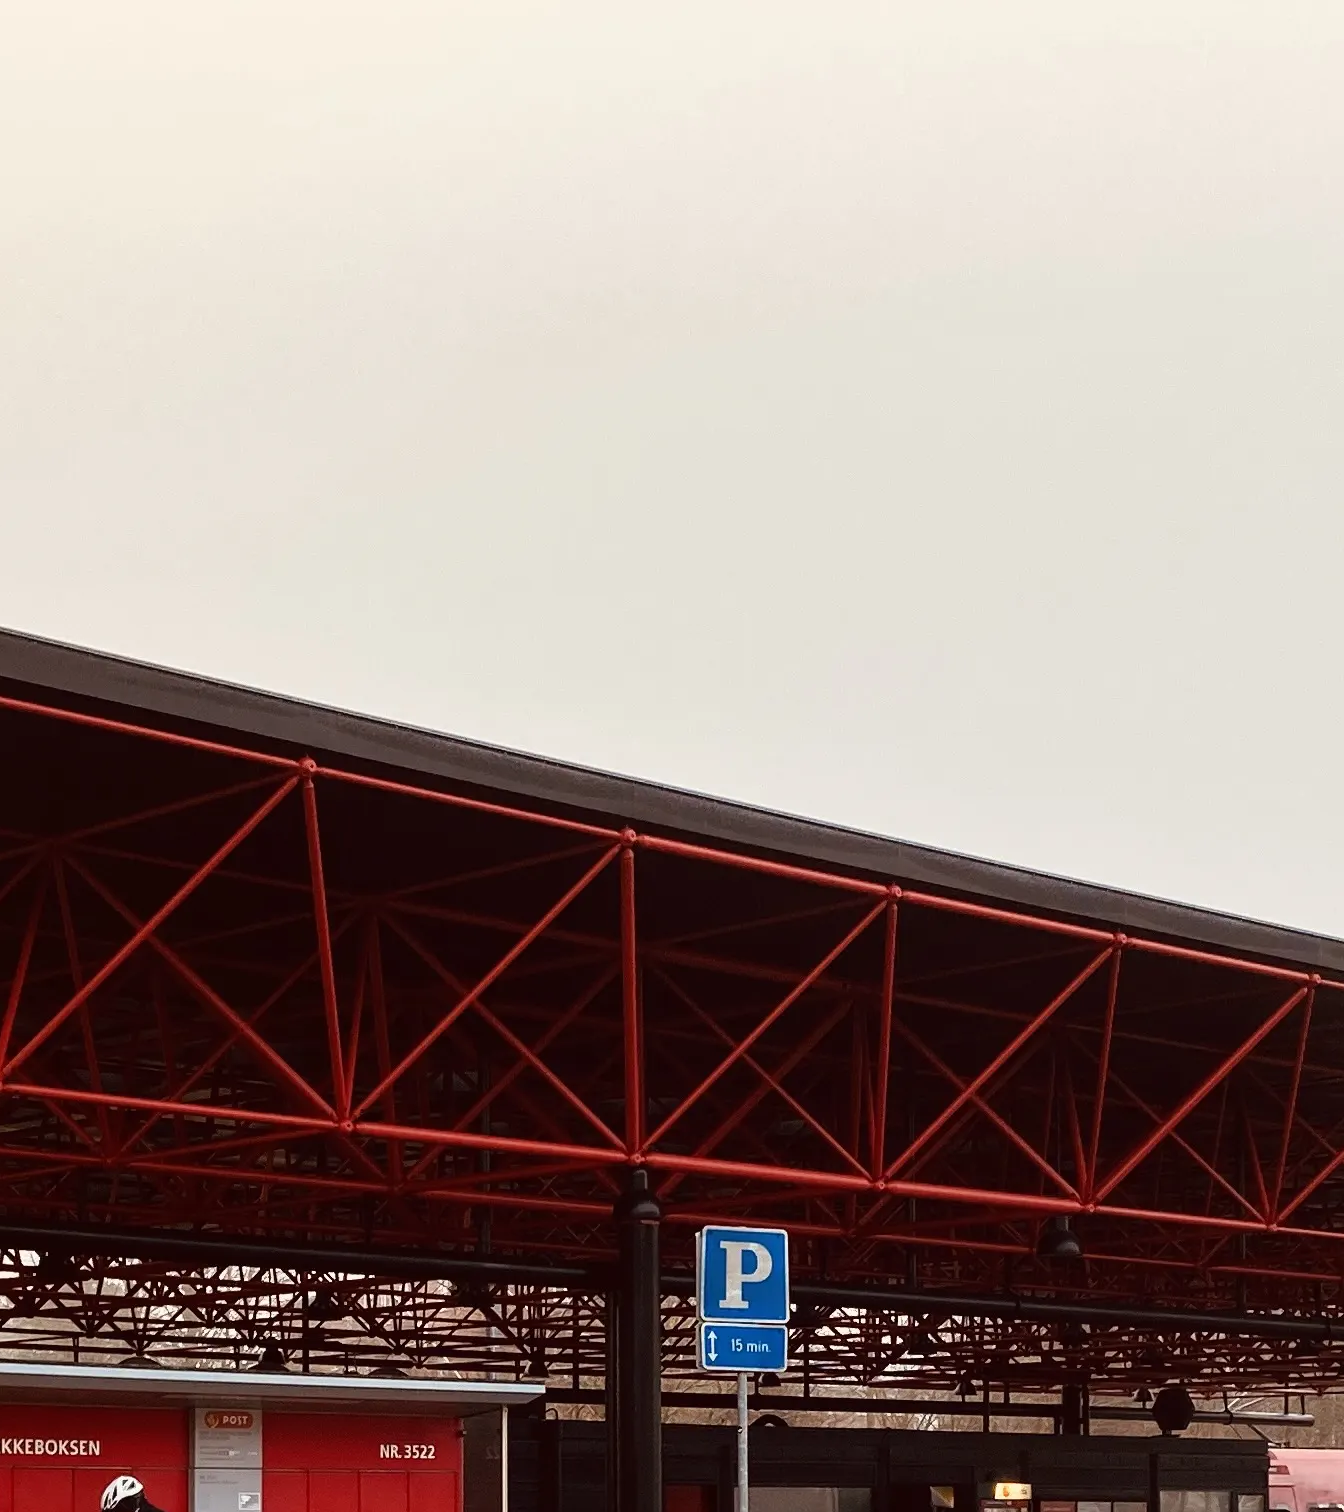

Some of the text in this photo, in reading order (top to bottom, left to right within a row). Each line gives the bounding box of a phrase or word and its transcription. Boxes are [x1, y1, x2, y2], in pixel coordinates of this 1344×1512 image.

[719, 1240, 773, 1309] P
[731, 1338, 772, 1353] 15 min.
[222, 1415, 249, 1426] POST
[380, 1444, 436, 1459] NR. 3522
